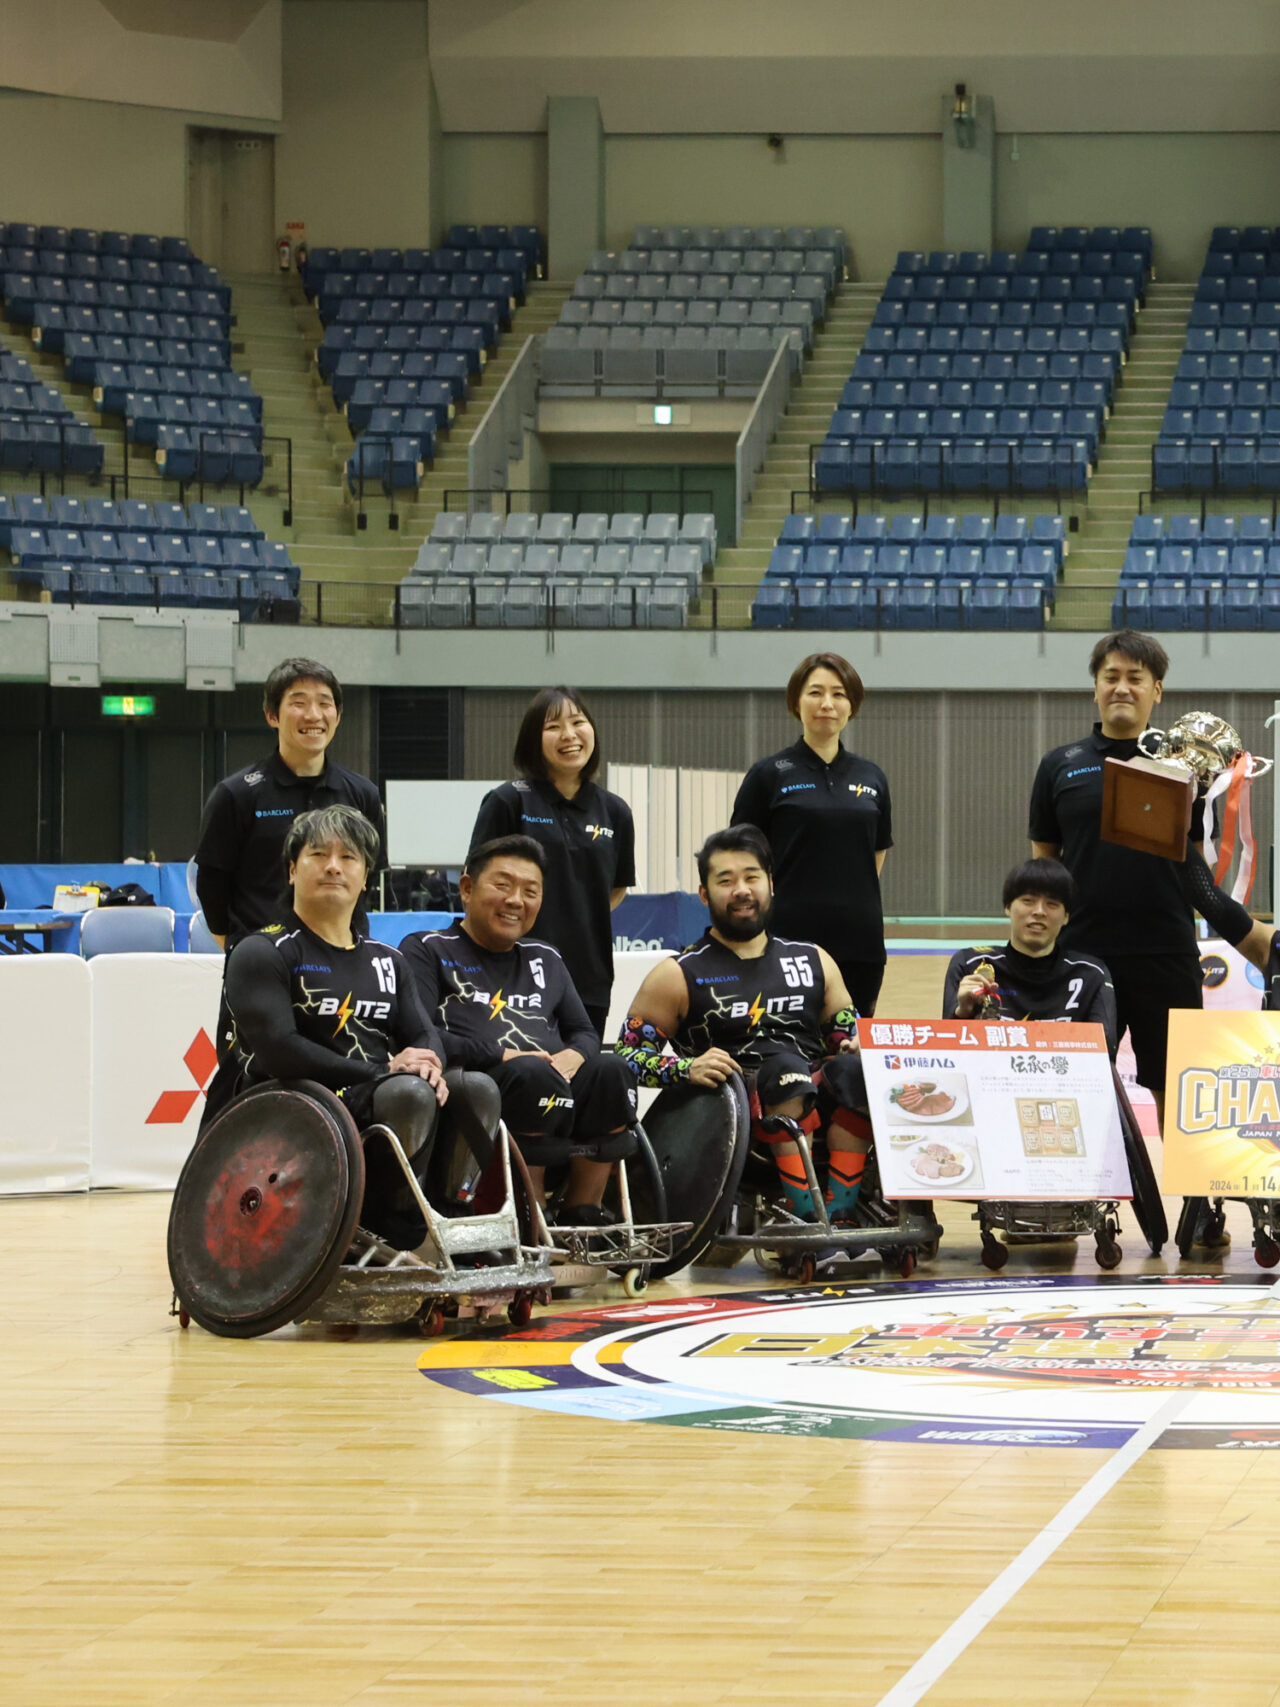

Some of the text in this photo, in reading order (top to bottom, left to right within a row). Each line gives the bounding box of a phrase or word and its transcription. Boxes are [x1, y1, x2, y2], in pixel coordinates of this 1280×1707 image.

[1073, 765, 1102, 776] BARCLAYS
[788, 783, 816, 792] BARCLAYS
[262, 808, 294, 817] BARCLAYS
[371, 956, 397, 995] 13
[529, 957, 546, 989] 5
[779, 956, 814, 988] 55
[704, 974, 739, 984] BARCLAYS
[1065, 978, 1083, 1010] 2
[870, 1024, 1030, 1048] 優勝チーム 副賞
[903, 1056, 956, 1069] 伊藤ハム
[1010, 1054, 1069, 1075] 伝承の響
[779, 1073, 812, 1086] JAPAN
[1242, 1130, 1272, 1138] JAPAN
